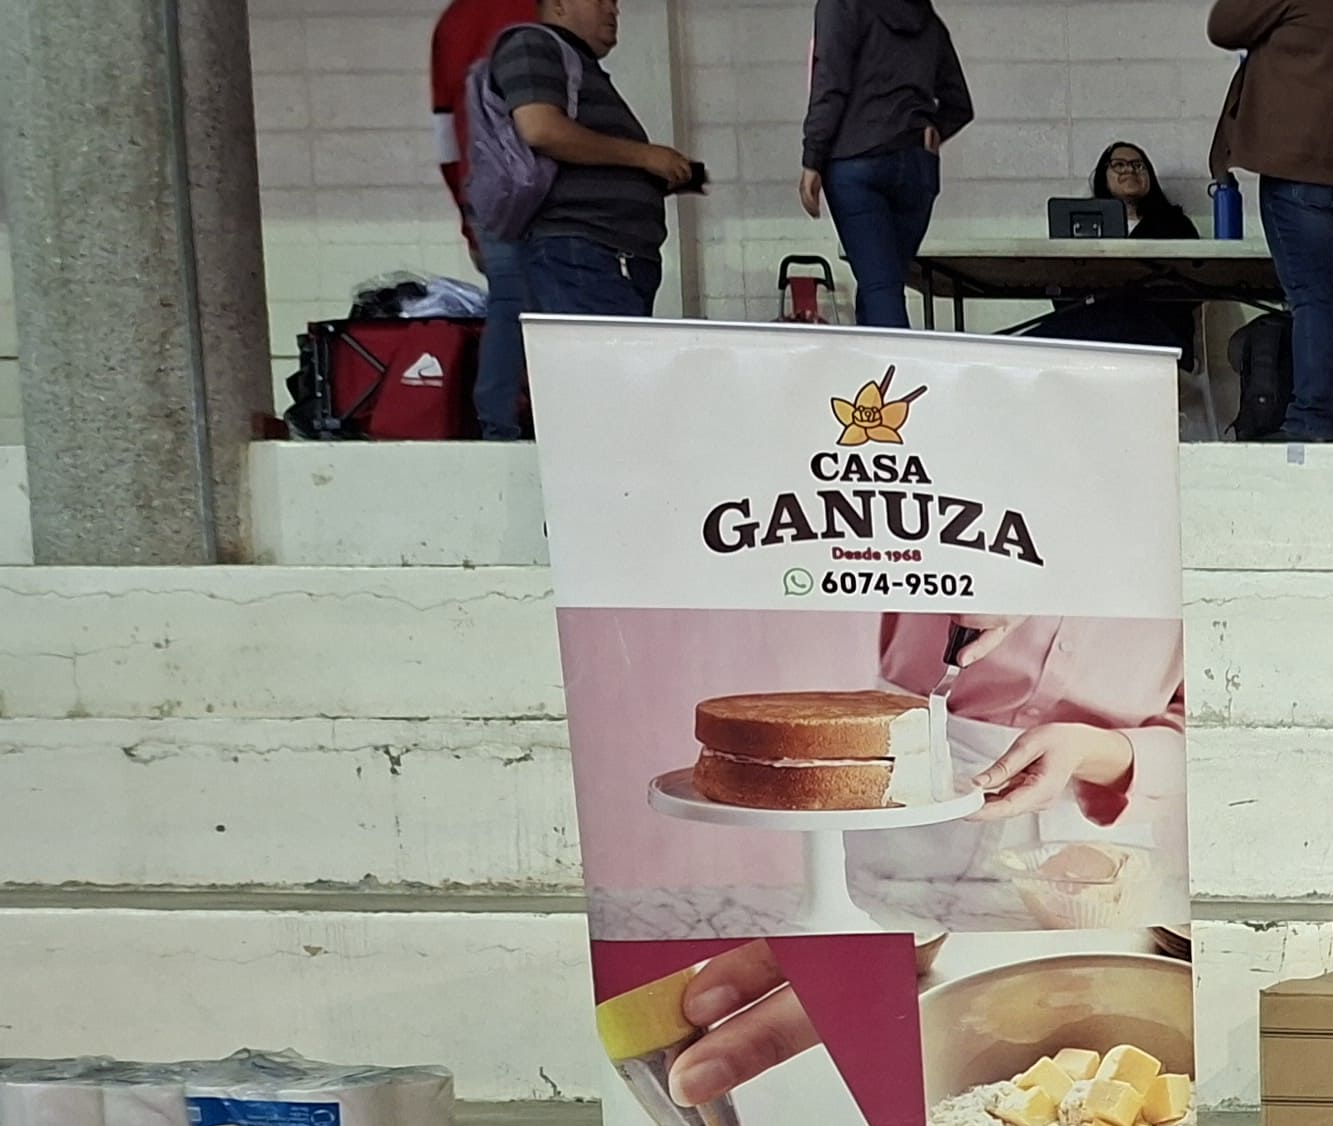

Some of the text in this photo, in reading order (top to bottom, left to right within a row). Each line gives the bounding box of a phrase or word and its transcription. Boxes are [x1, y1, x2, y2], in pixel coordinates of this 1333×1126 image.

[810, 452, 931, 484] CASA
[702, 490, 1044, 566] GANUZA
[831, 546, 922, 563] Desde 1968
[821, 571, 974, 598] 6074-9502
